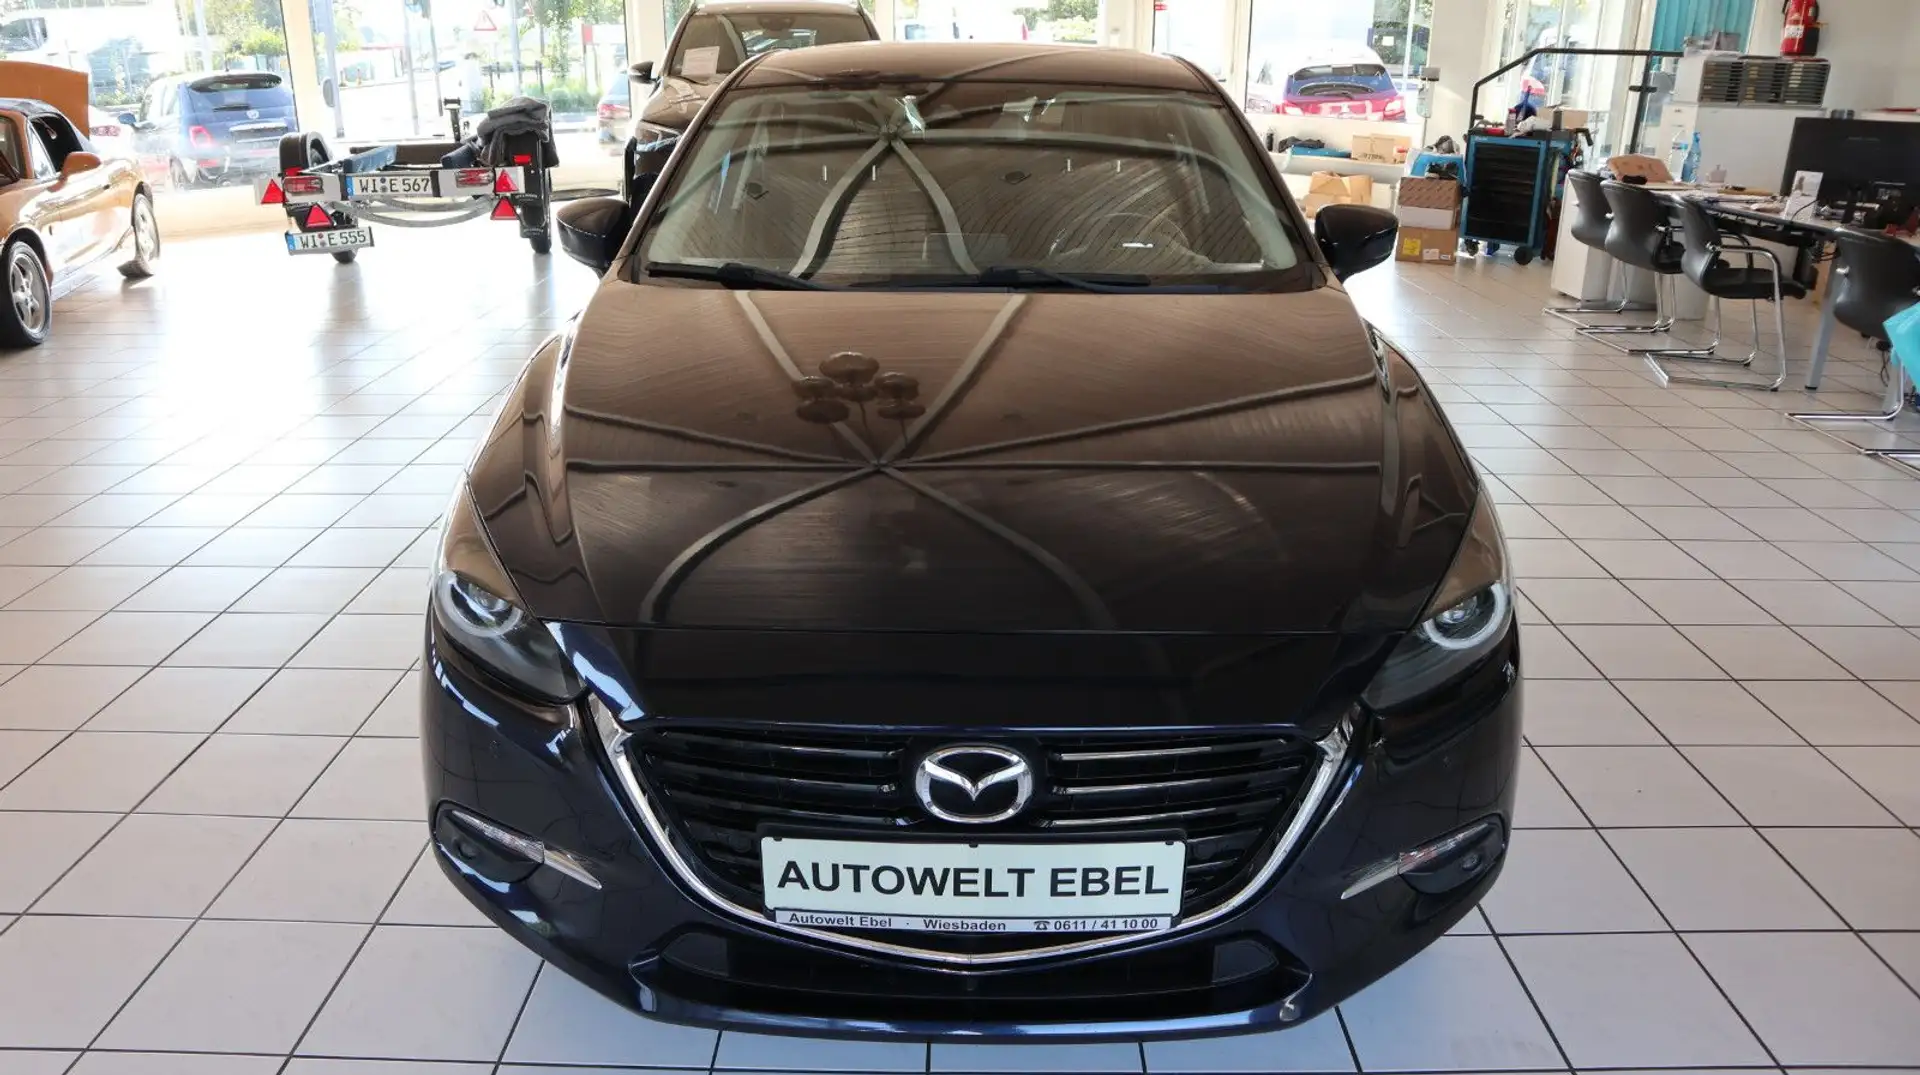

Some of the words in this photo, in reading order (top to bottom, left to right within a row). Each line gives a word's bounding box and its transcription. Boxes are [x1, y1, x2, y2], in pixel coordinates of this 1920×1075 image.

[359, 178, 378, 193] WI
[389, 178, 399, 193] E
[402, 177, 430, 193] 567
[300, 235, 318, 249] WI
[328, 233, 338, 247] E
[340, 230, 367, 245] 555
[777, 860, 1036, 898] AUTOWELT
[1050, 865, 1169, 897] EBEL
[788, 912, 855, 927] Autowelt
[859, 916, 892, 928] Ebel
[923, 918, 1006, 931] Wiesbaden
[1053, 920, 1087, 931] 0611
[1100, 920, 1117, 930] 41
[1122, 919, 1138, 929] 10
[1141, 918, 1158, 929] 00
